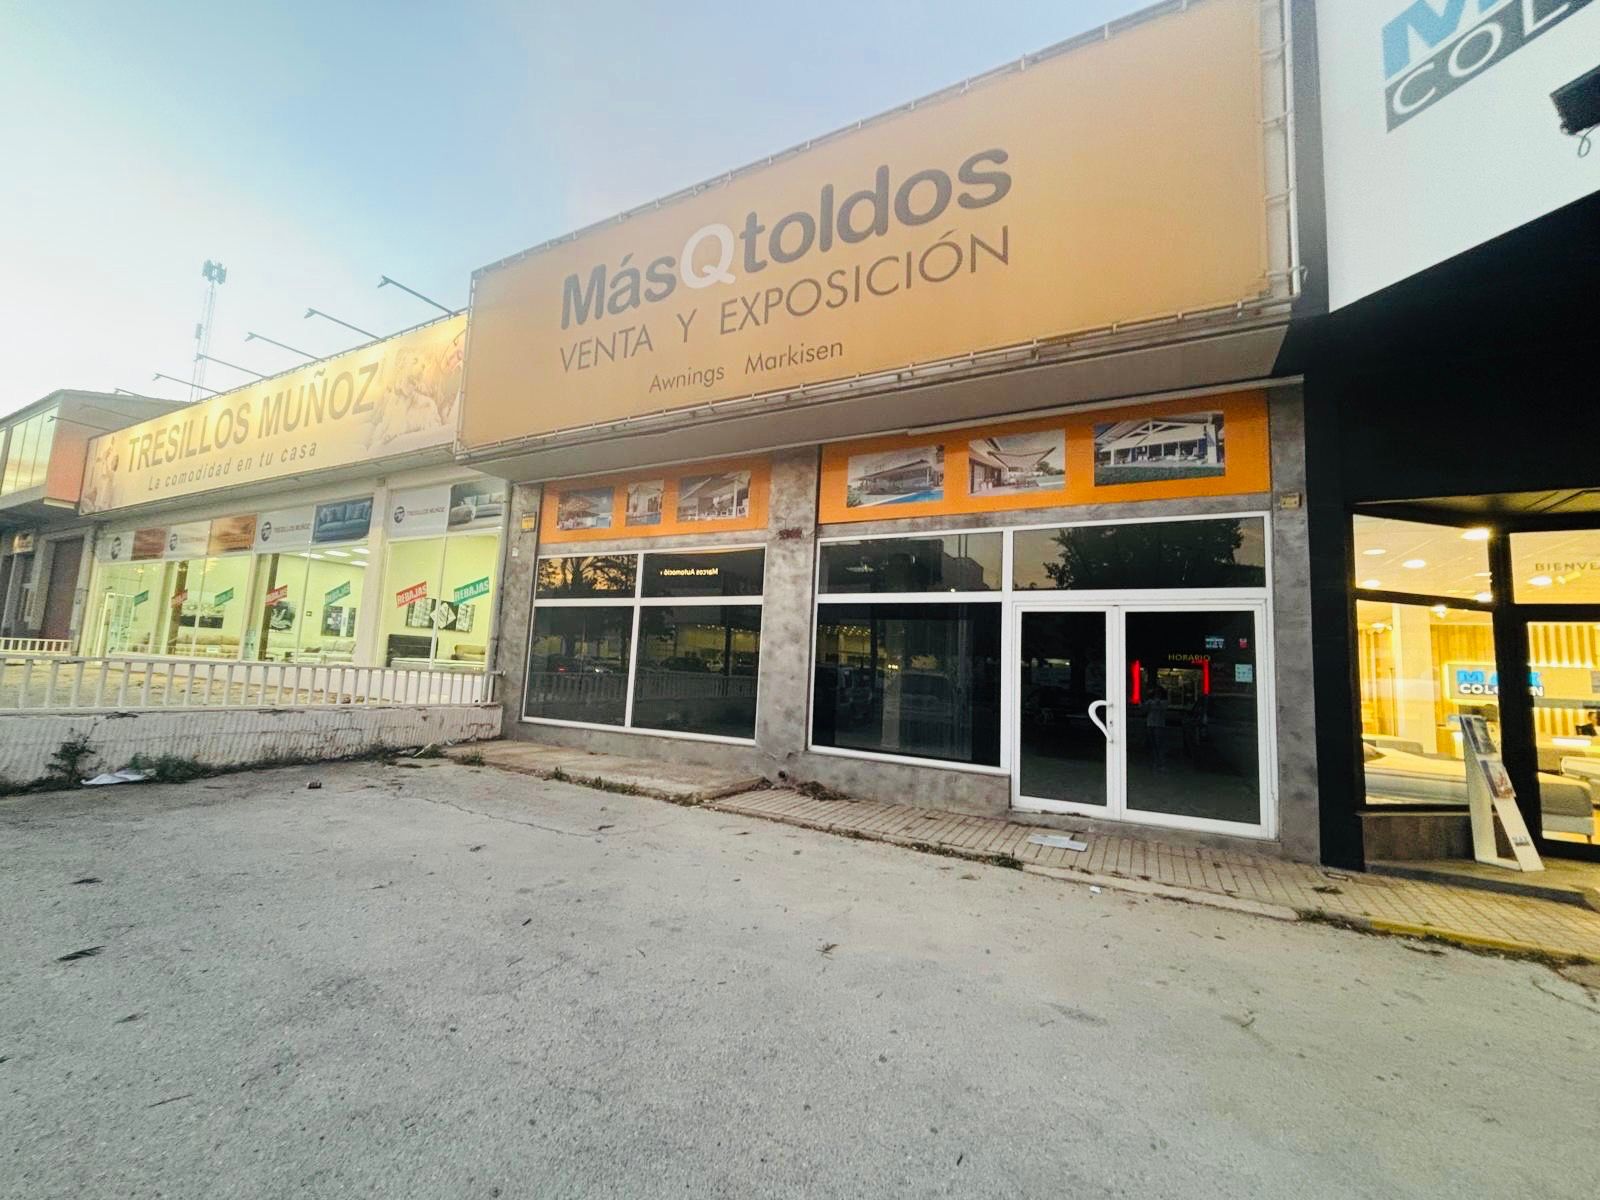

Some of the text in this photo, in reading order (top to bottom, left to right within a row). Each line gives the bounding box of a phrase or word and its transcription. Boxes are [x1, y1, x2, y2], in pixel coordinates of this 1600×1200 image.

[560, 148, 1012, 330] MásQtoldos
[560, 225, 1010, 373] VENTA Y EXPOSICIÓN
[128, 362, 379, 473] TRESILLOS MUÑOZ
[648, 340, 844, 394] Awnings Markisen
[148, 441, 318, 491] La comodidad en tu casa
